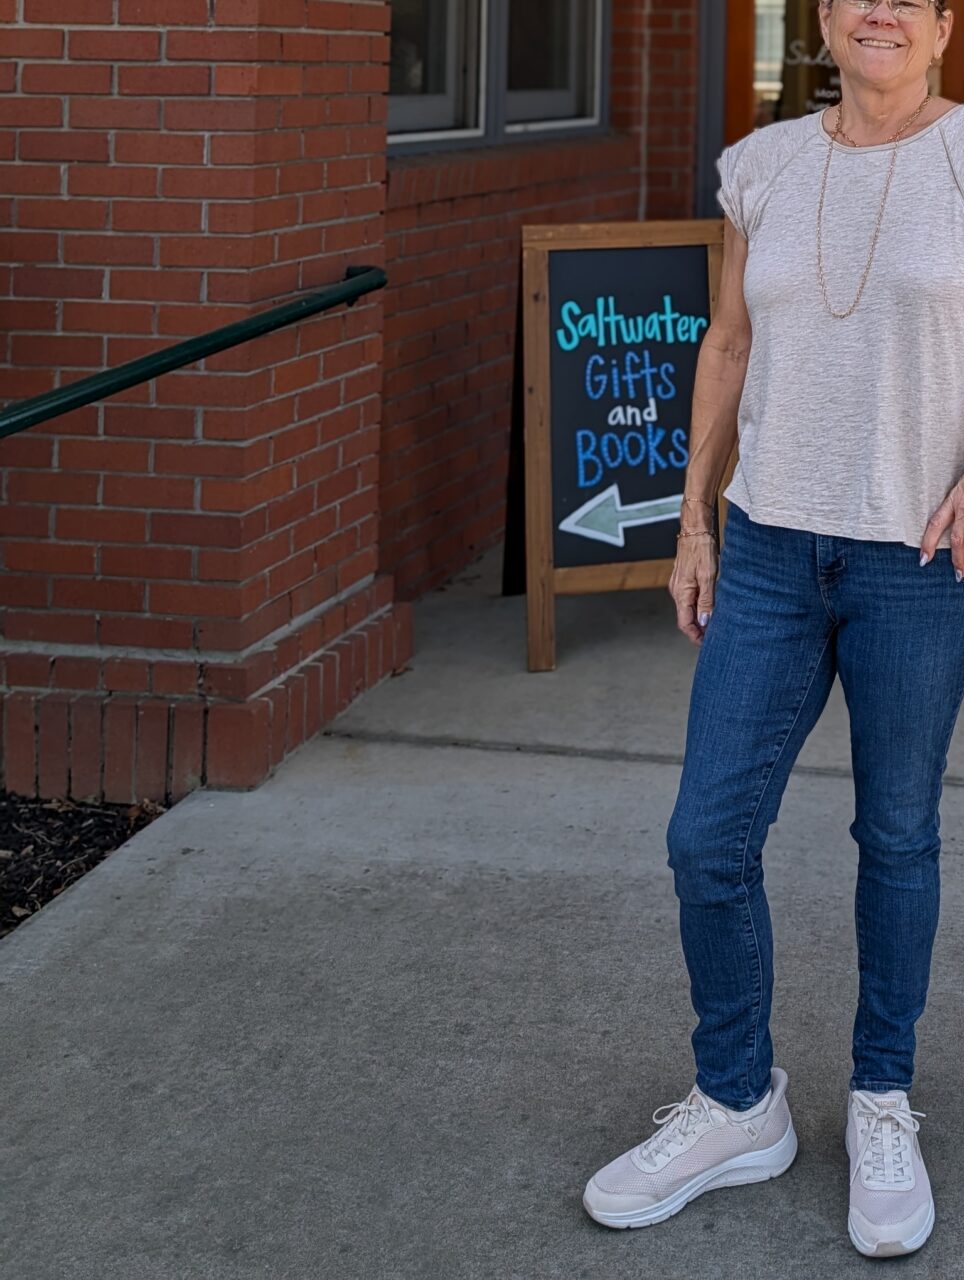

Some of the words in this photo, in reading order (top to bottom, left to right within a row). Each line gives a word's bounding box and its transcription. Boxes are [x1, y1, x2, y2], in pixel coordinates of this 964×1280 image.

[556, 295, 707, 351] Saltwater
[585, 350, 676, 400] Gifts
[607, 397, 657, 427] and
